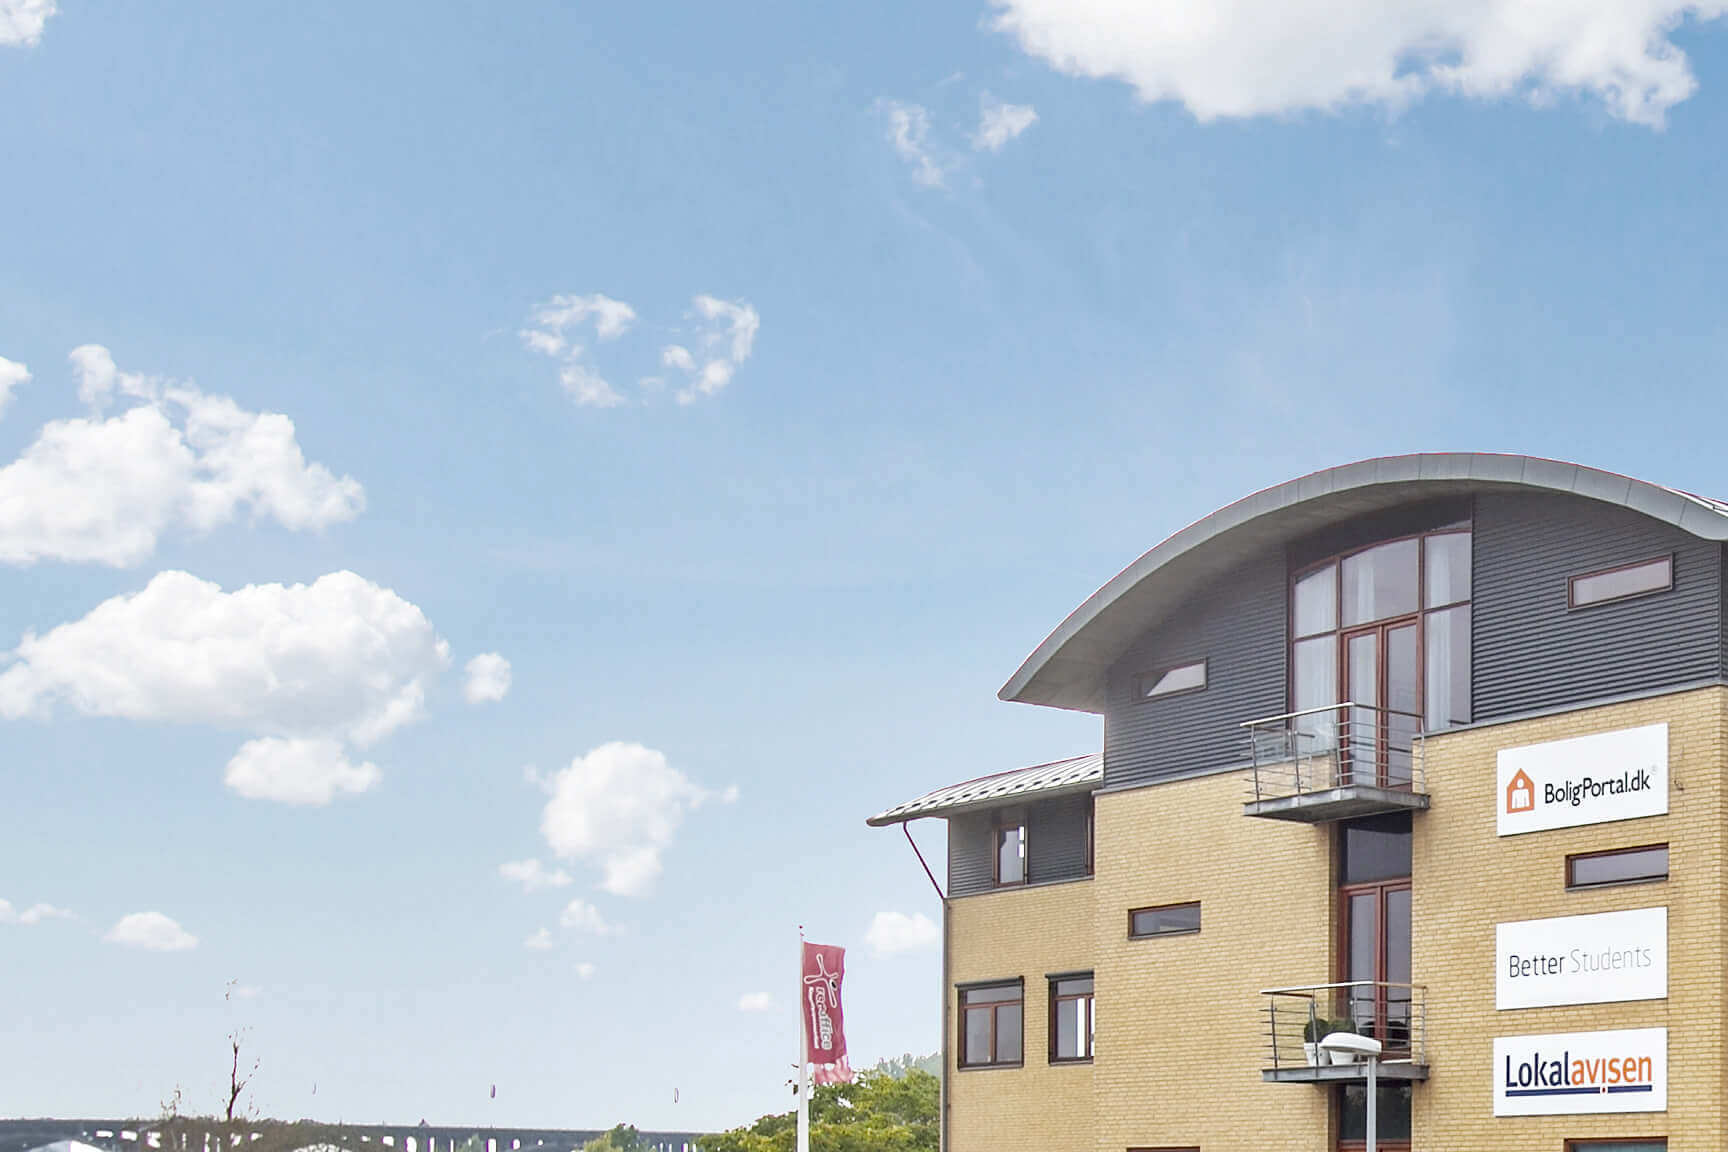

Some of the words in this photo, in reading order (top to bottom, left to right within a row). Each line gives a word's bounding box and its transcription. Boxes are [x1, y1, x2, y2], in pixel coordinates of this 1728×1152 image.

[1544, 769, 1651, 807] BoligPortal.dk
[1508, 954, 1566, 978] Better
[1570, 946, 1652, 974] Students
[1505, 1050, 1653, 1090] Lokalavisen
